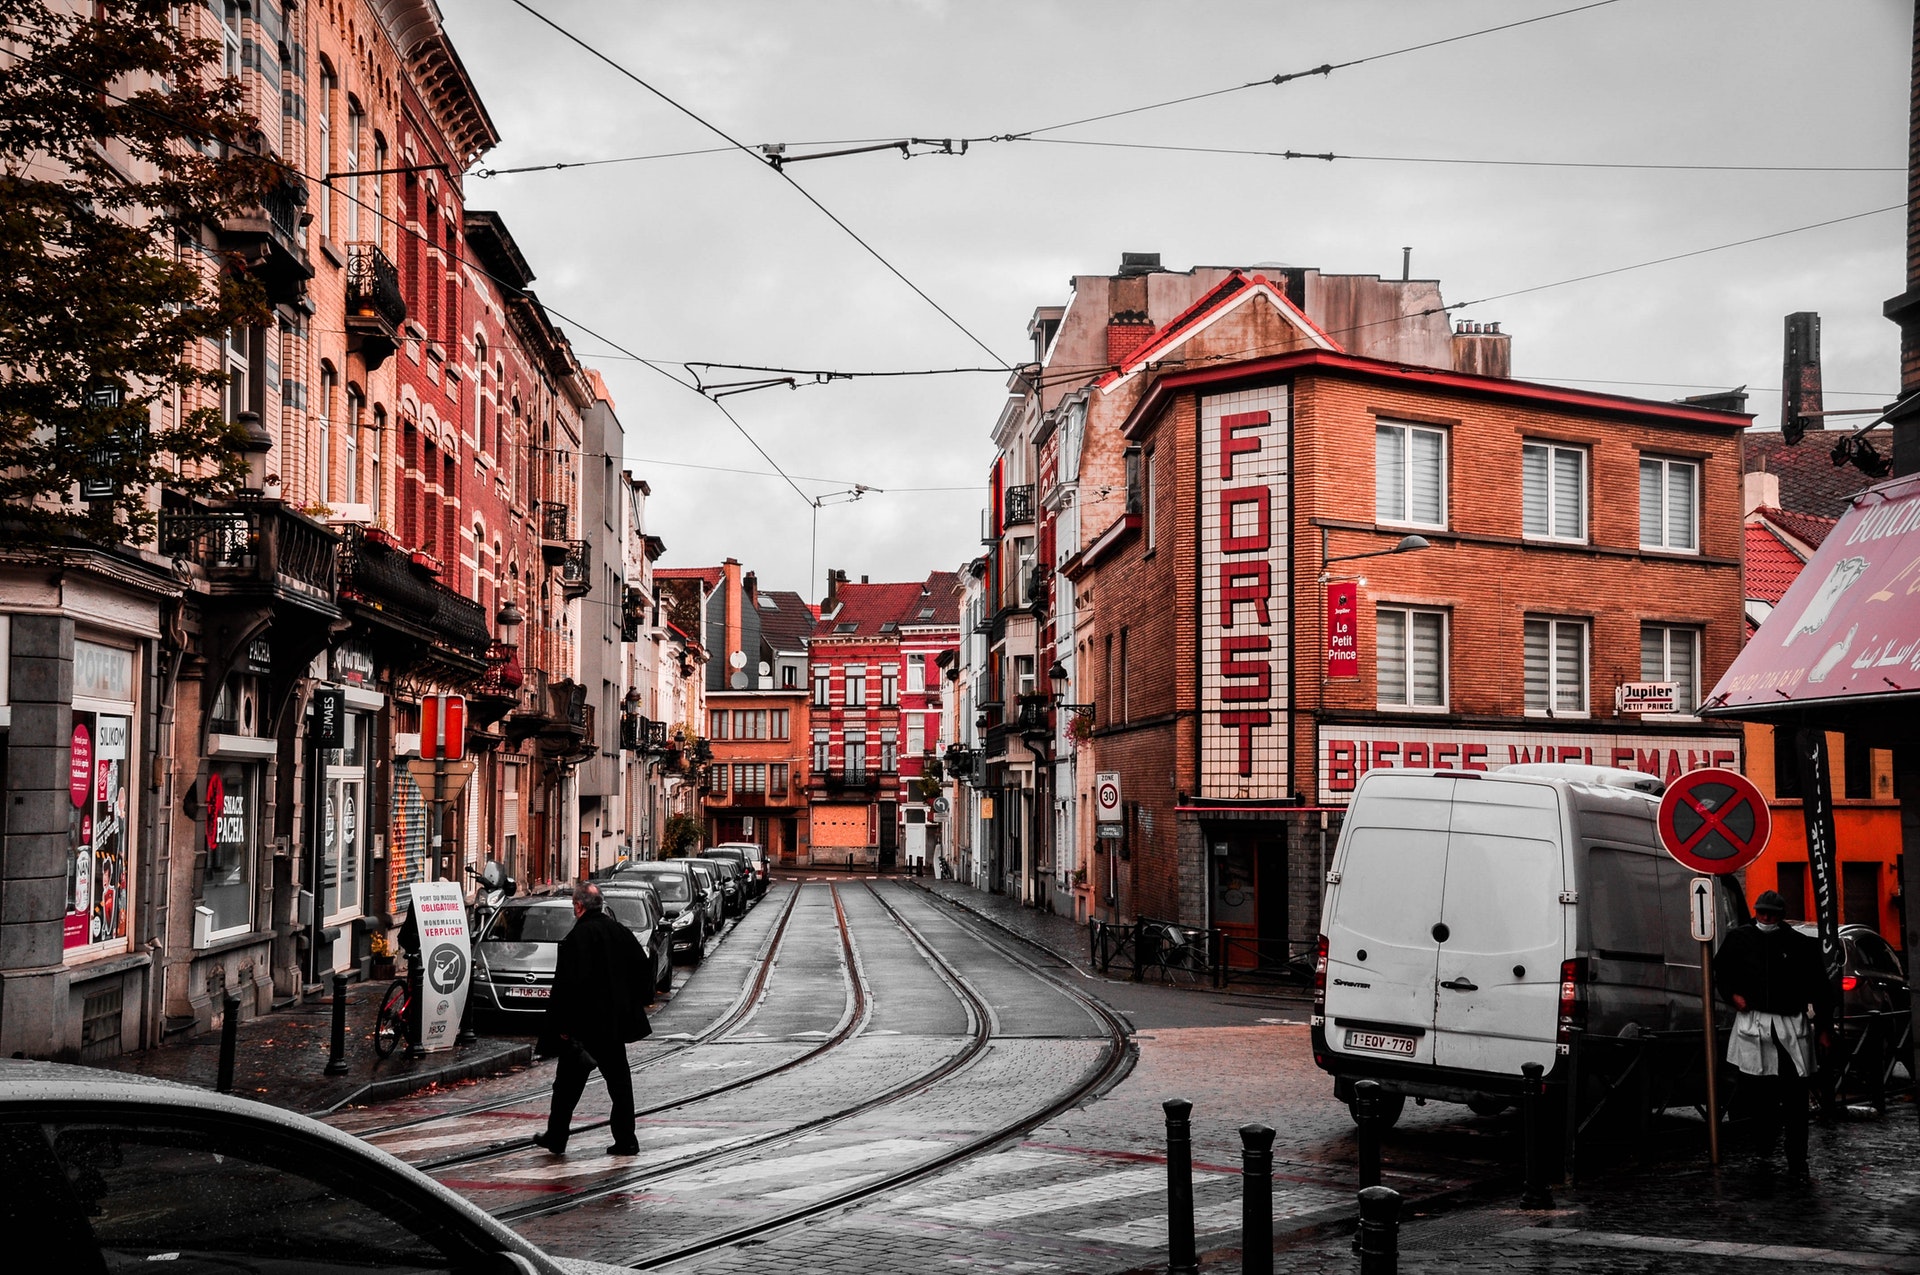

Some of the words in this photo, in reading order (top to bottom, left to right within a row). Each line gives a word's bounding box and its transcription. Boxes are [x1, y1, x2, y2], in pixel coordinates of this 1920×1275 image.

[1220, 410, 1271, 778] FORST
[1337, 622, 1348, 633] Le
[1332, 635, 1352, 646] Petit
[249, 640, 270, 663] PACHA
[1328, 649, 1356, 660] Prince
[1625, 685, 1672, 700] Jupiler
[323, 696, 335, 725] MAES
[1104, 791, 1114, 801] 30
[224, 796, 244, 815] SNACK
[216, 817, 244, 843] PACHA
[421, 903, 459, 912] OBLIGATOIRE
[425, 927, 462, 936] VERPLICHT
